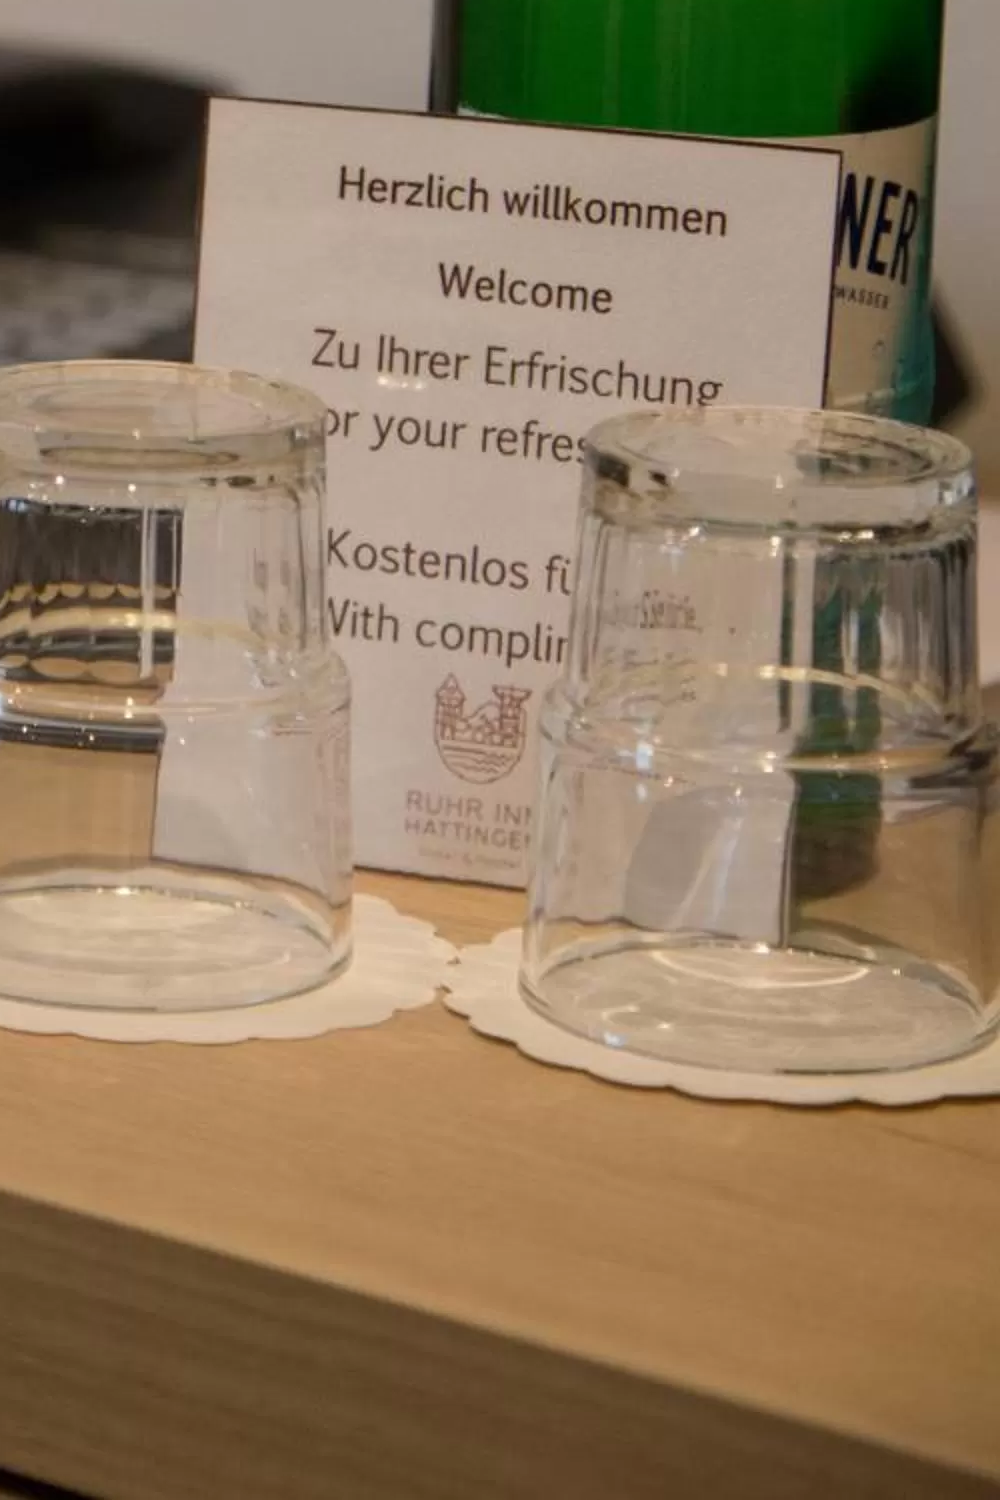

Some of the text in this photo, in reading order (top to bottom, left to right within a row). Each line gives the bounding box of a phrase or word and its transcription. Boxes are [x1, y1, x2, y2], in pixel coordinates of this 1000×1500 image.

[338, 165, 728, 237] Herzlich willkommen
[838, 171, 919, 287] NER
[438, 261, 614, 314] Welcome
[834, 285, 889, 310] WASSER
[311, 328, 725, 408] Zu Ihrer Erfrischung
[326, 407, 360, 438] or
[368, 413, 467, 452] your
[327, 527, 529, 590] Kostenlos
[406, 789, 484, 822] RUHR
